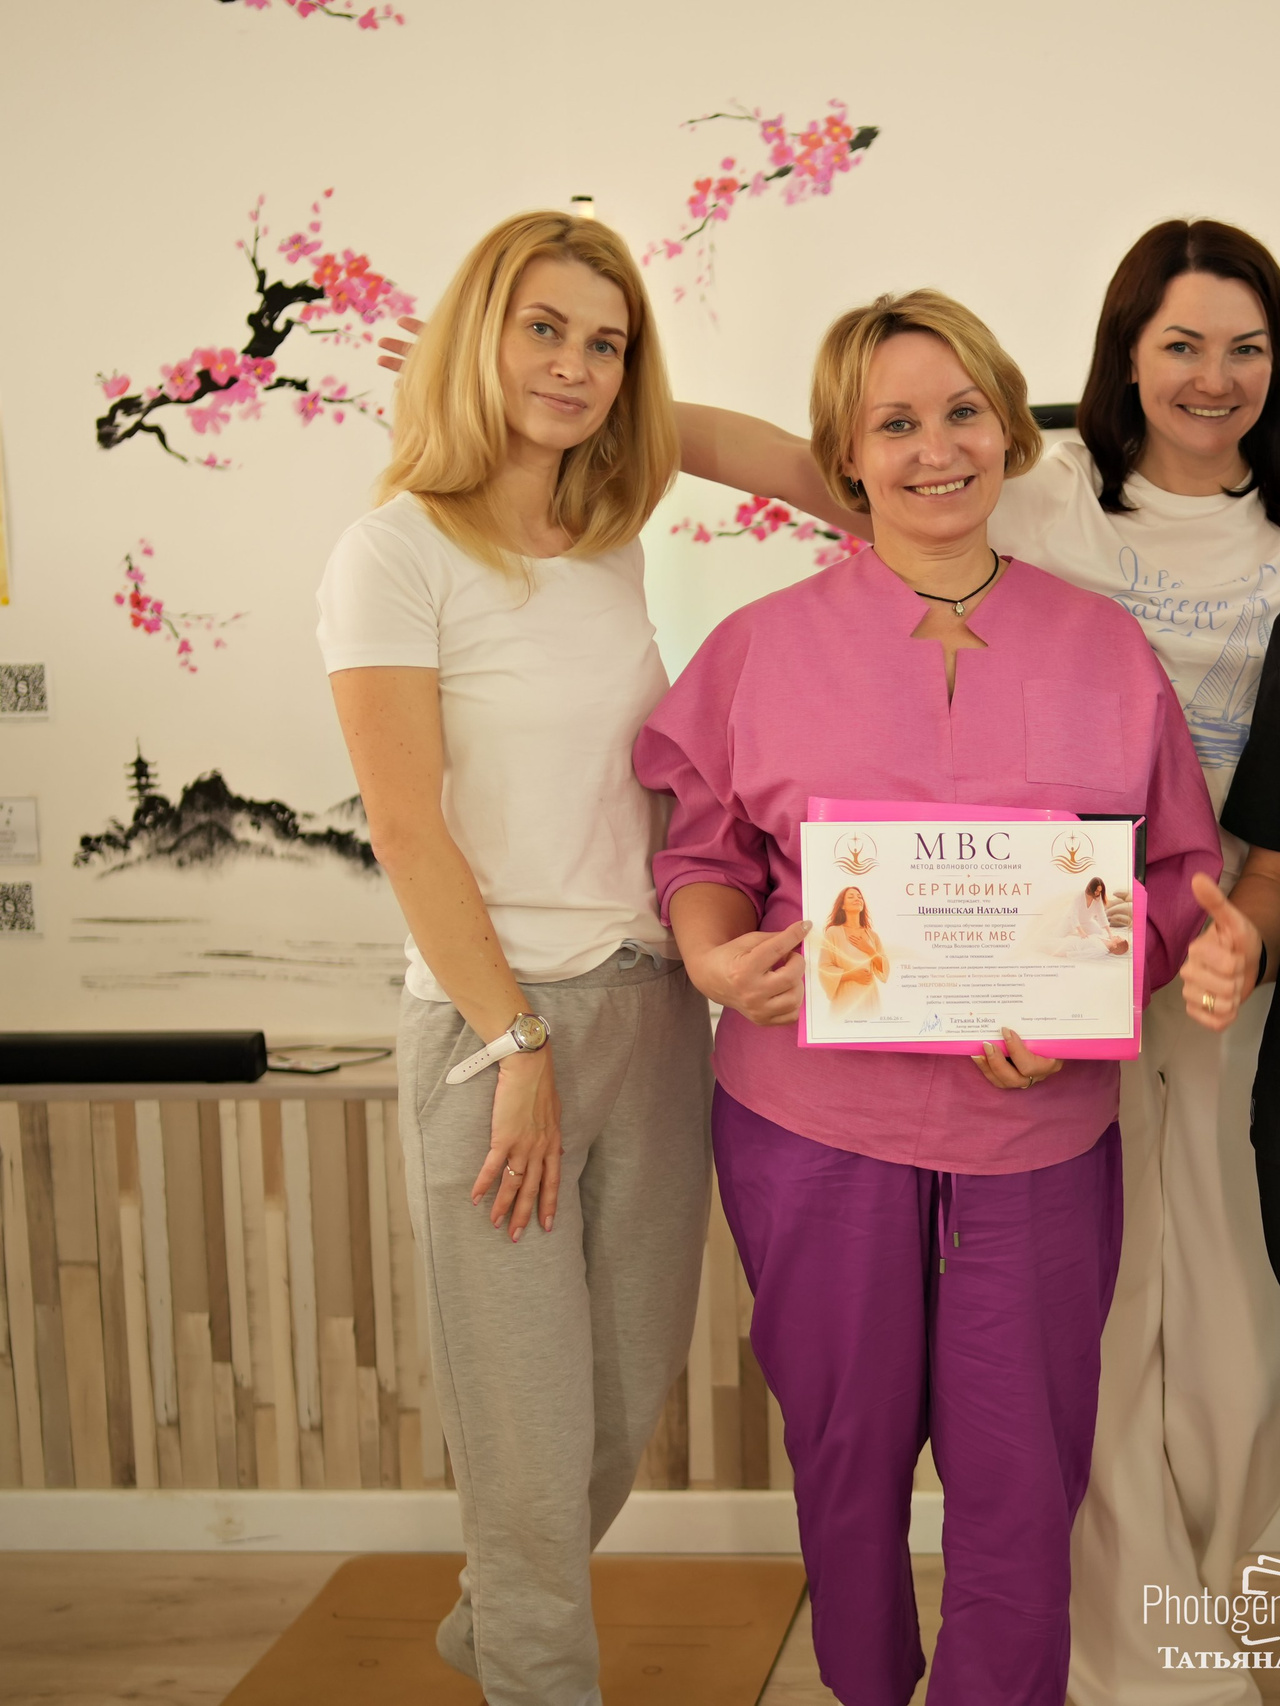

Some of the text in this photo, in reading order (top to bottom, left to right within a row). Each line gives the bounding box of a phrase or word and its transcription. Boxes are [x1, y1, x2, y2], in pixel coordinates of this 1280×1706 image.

[914, 832, 1010, 860] МВС
[905, 883, 1033, 896] СЕРТИФИКАТ
[924, 931, 1016, 941] ПРАКТИК МВС
